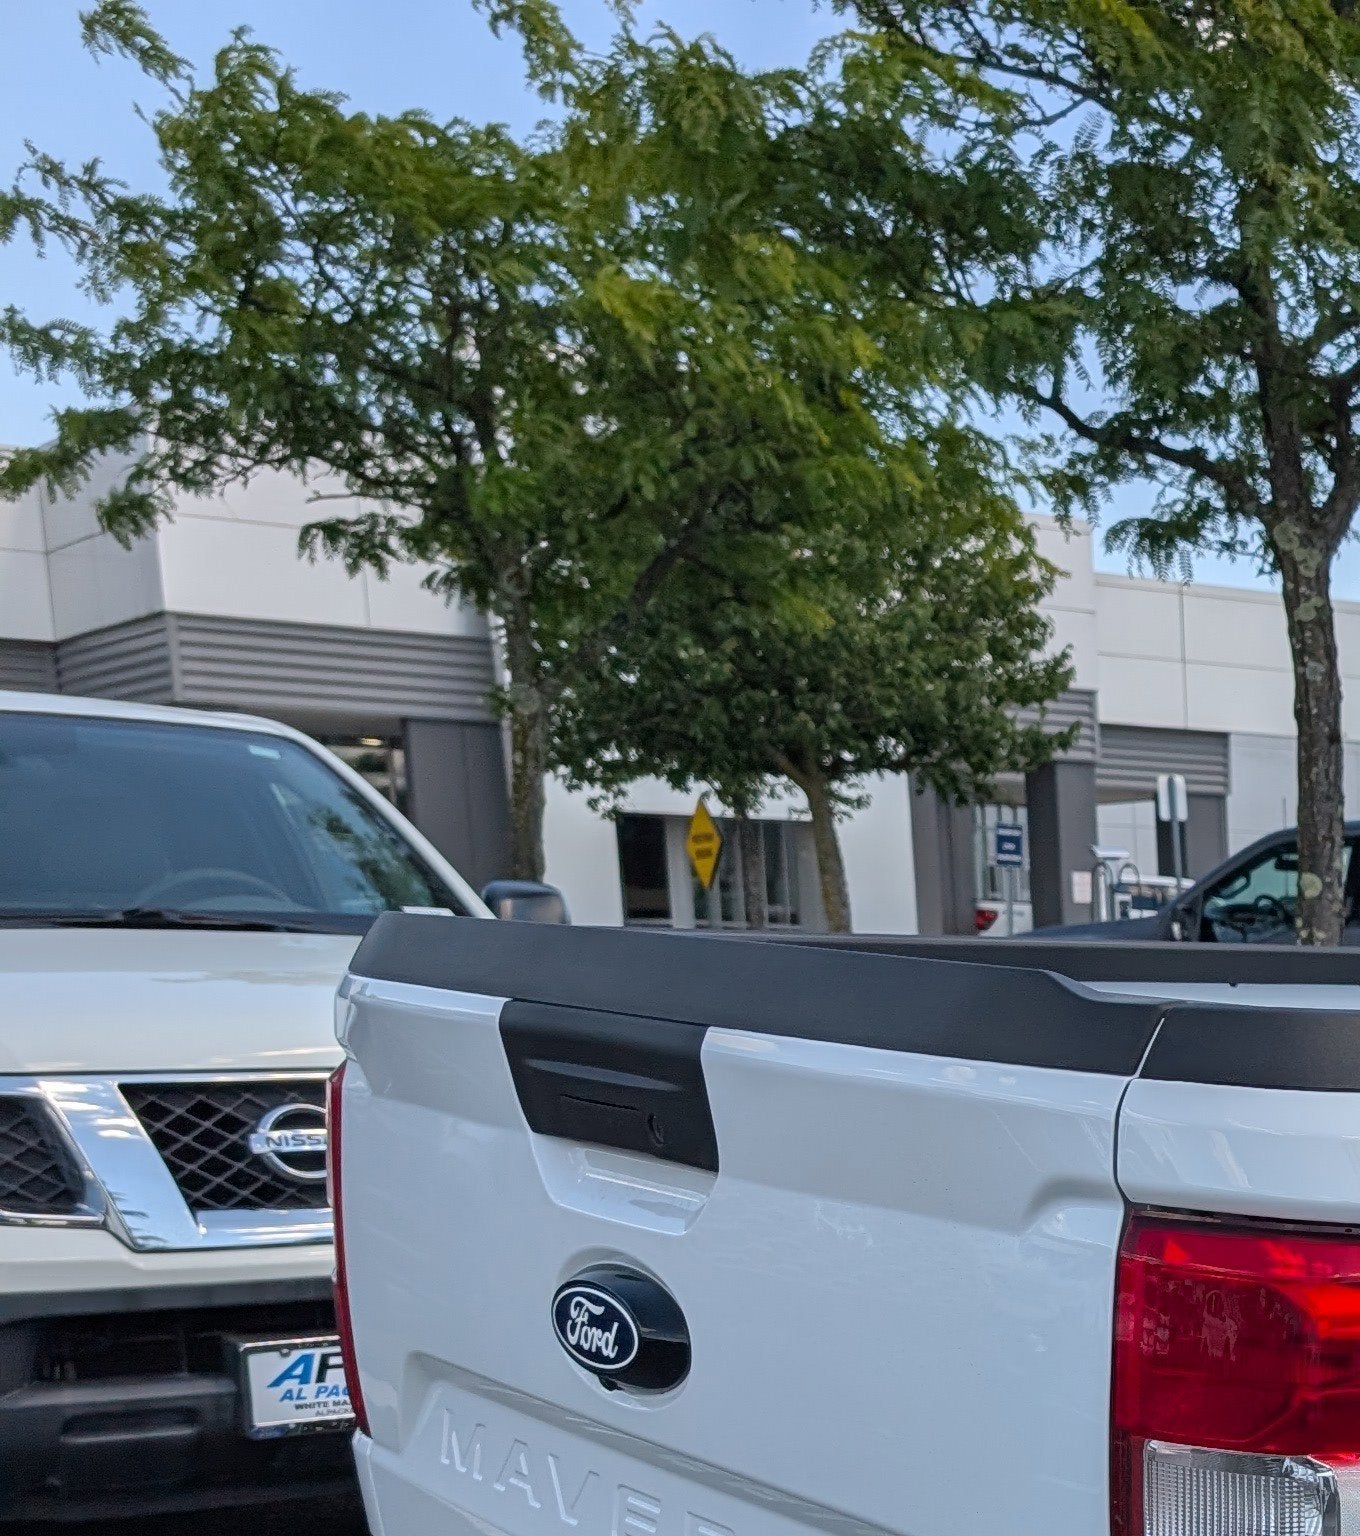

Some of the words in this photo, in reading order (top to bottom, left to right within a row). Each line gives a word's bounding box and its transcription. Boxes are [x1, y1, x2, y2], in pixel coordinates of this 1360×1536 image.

[265, 1133, 327, 1149] NISS
[567, 1296, 619, 1359] Ford
[279, 1388, 307, 1402] AL
